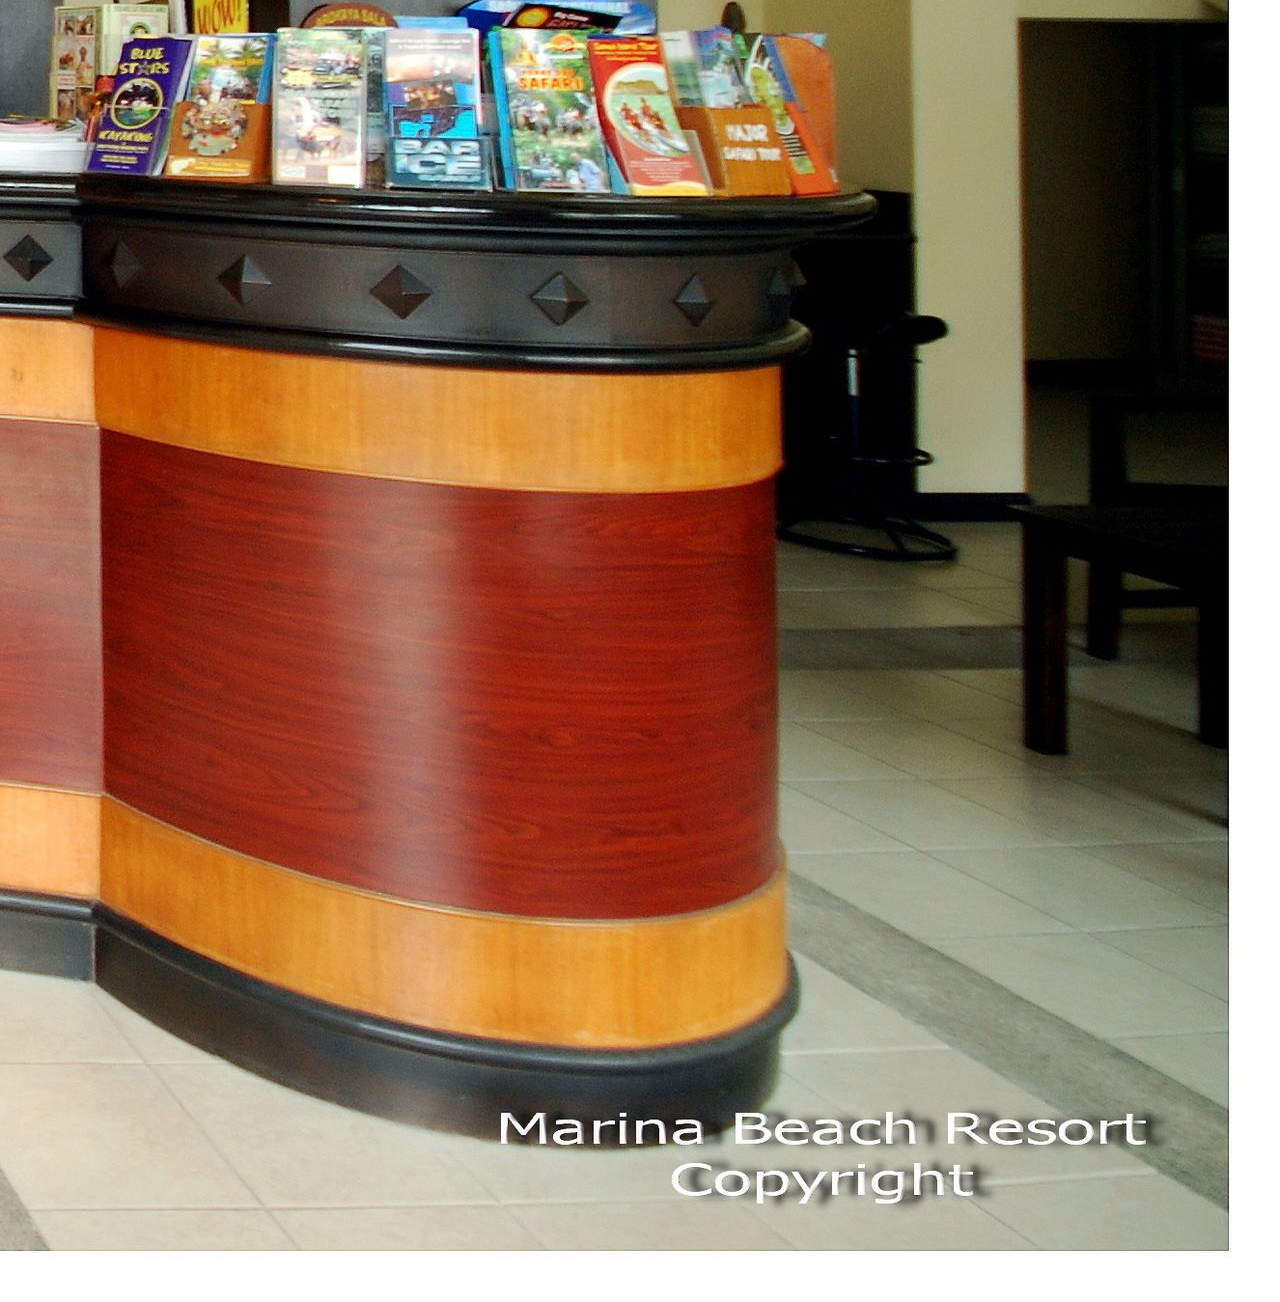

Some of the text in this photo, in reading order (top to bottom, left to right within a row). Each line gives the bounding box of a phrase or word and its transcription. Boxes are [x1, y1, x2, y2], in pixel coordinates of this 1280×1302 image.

[130, 47, 165, 60] BLUE
[518, 75, 585, 91] SAFARI
[98, 130, 154, 143] KAYAKING
[726, 123, 769, 142] MAJOR
[394, 154, 482, 176] ICE
